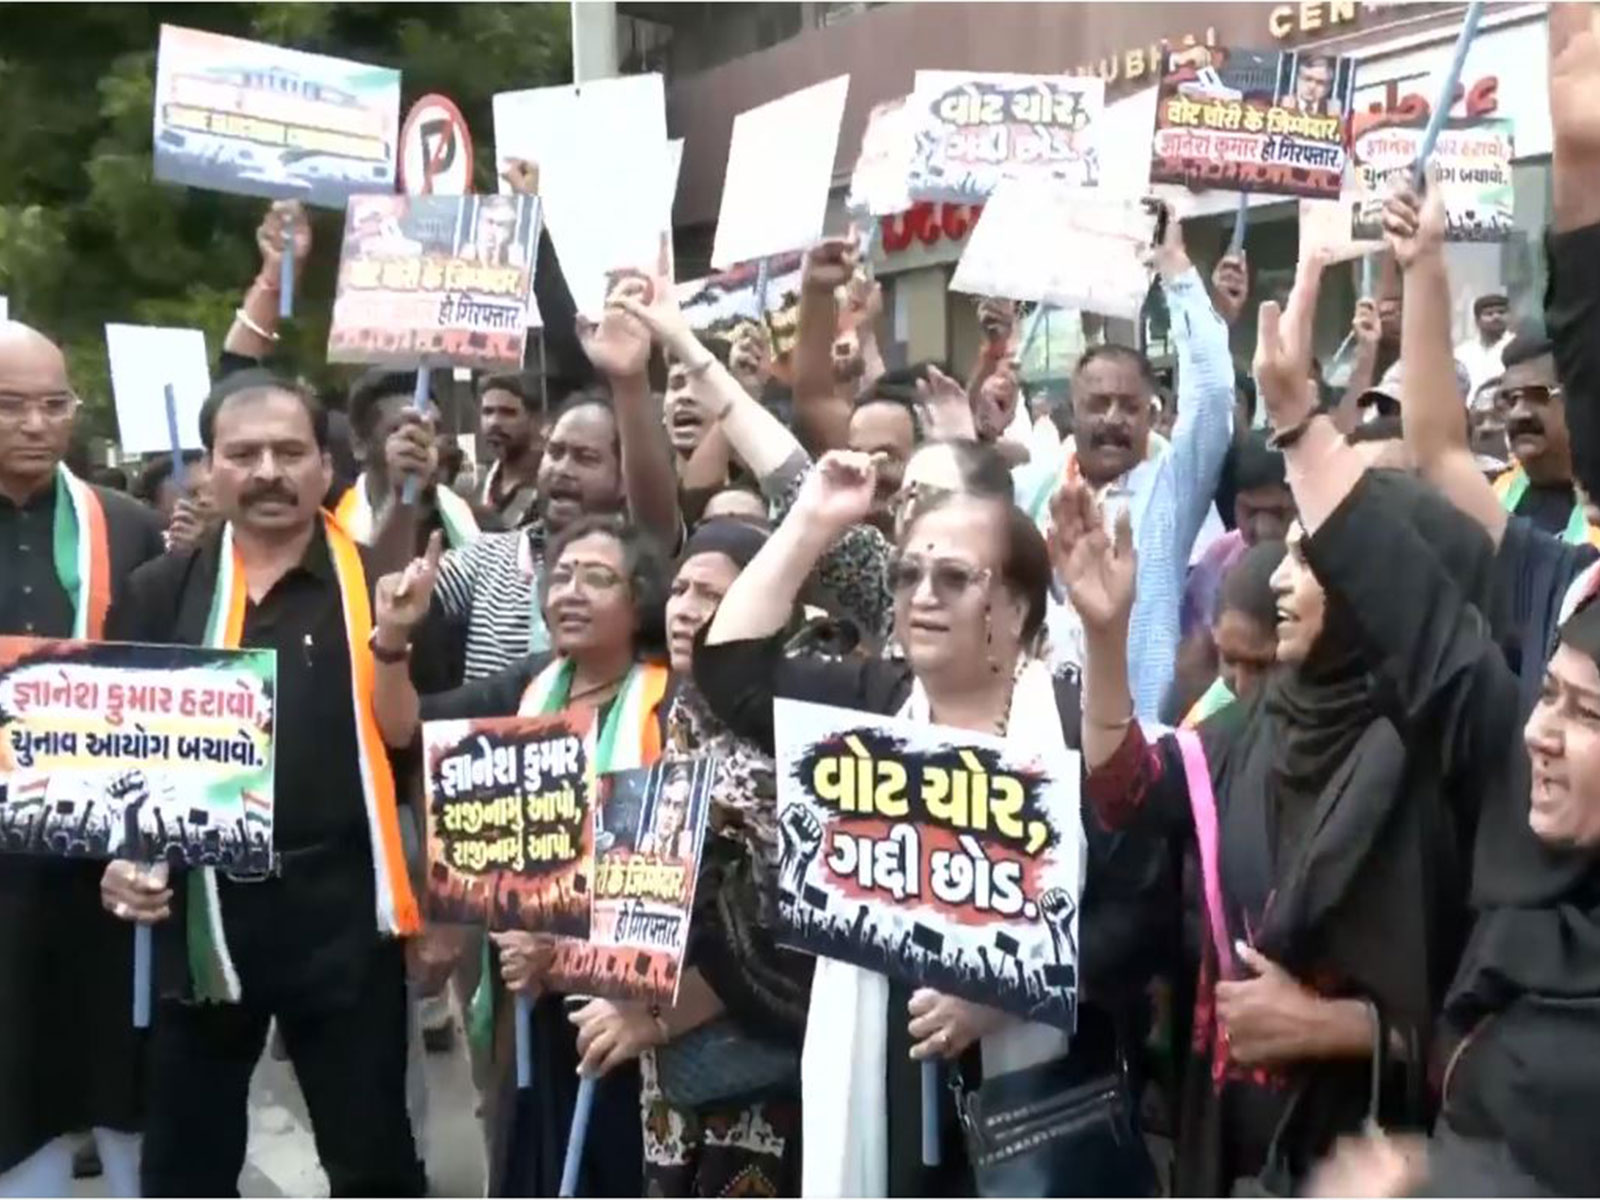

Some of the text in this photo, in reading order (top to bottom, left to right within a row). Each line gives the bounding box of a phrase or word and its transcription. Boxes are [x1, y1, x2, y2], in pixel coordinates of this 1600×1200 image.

[1244, 105, 1264, 131] के
[1260, 135, 1277, 162] हो
[438, 294, 453, 326] हो
[12, 669, 98, 712] જ્ઞાનેશ
[105, 683, 173, 726] કુમાર
[11, 722, 264, 768] ચુનાવ આયોગ બચાવો.
[524, 736, 580, 792] કુમાર
[526, 779, 582, 826] આપો,
[813, 733, 1048, 856] વોટ ચોર,
[527, 825, 577, 862] આપો.
[825, 823, 1040, 920] ગદ્દી છોડ.
[614, 901, 629, 943] हो
